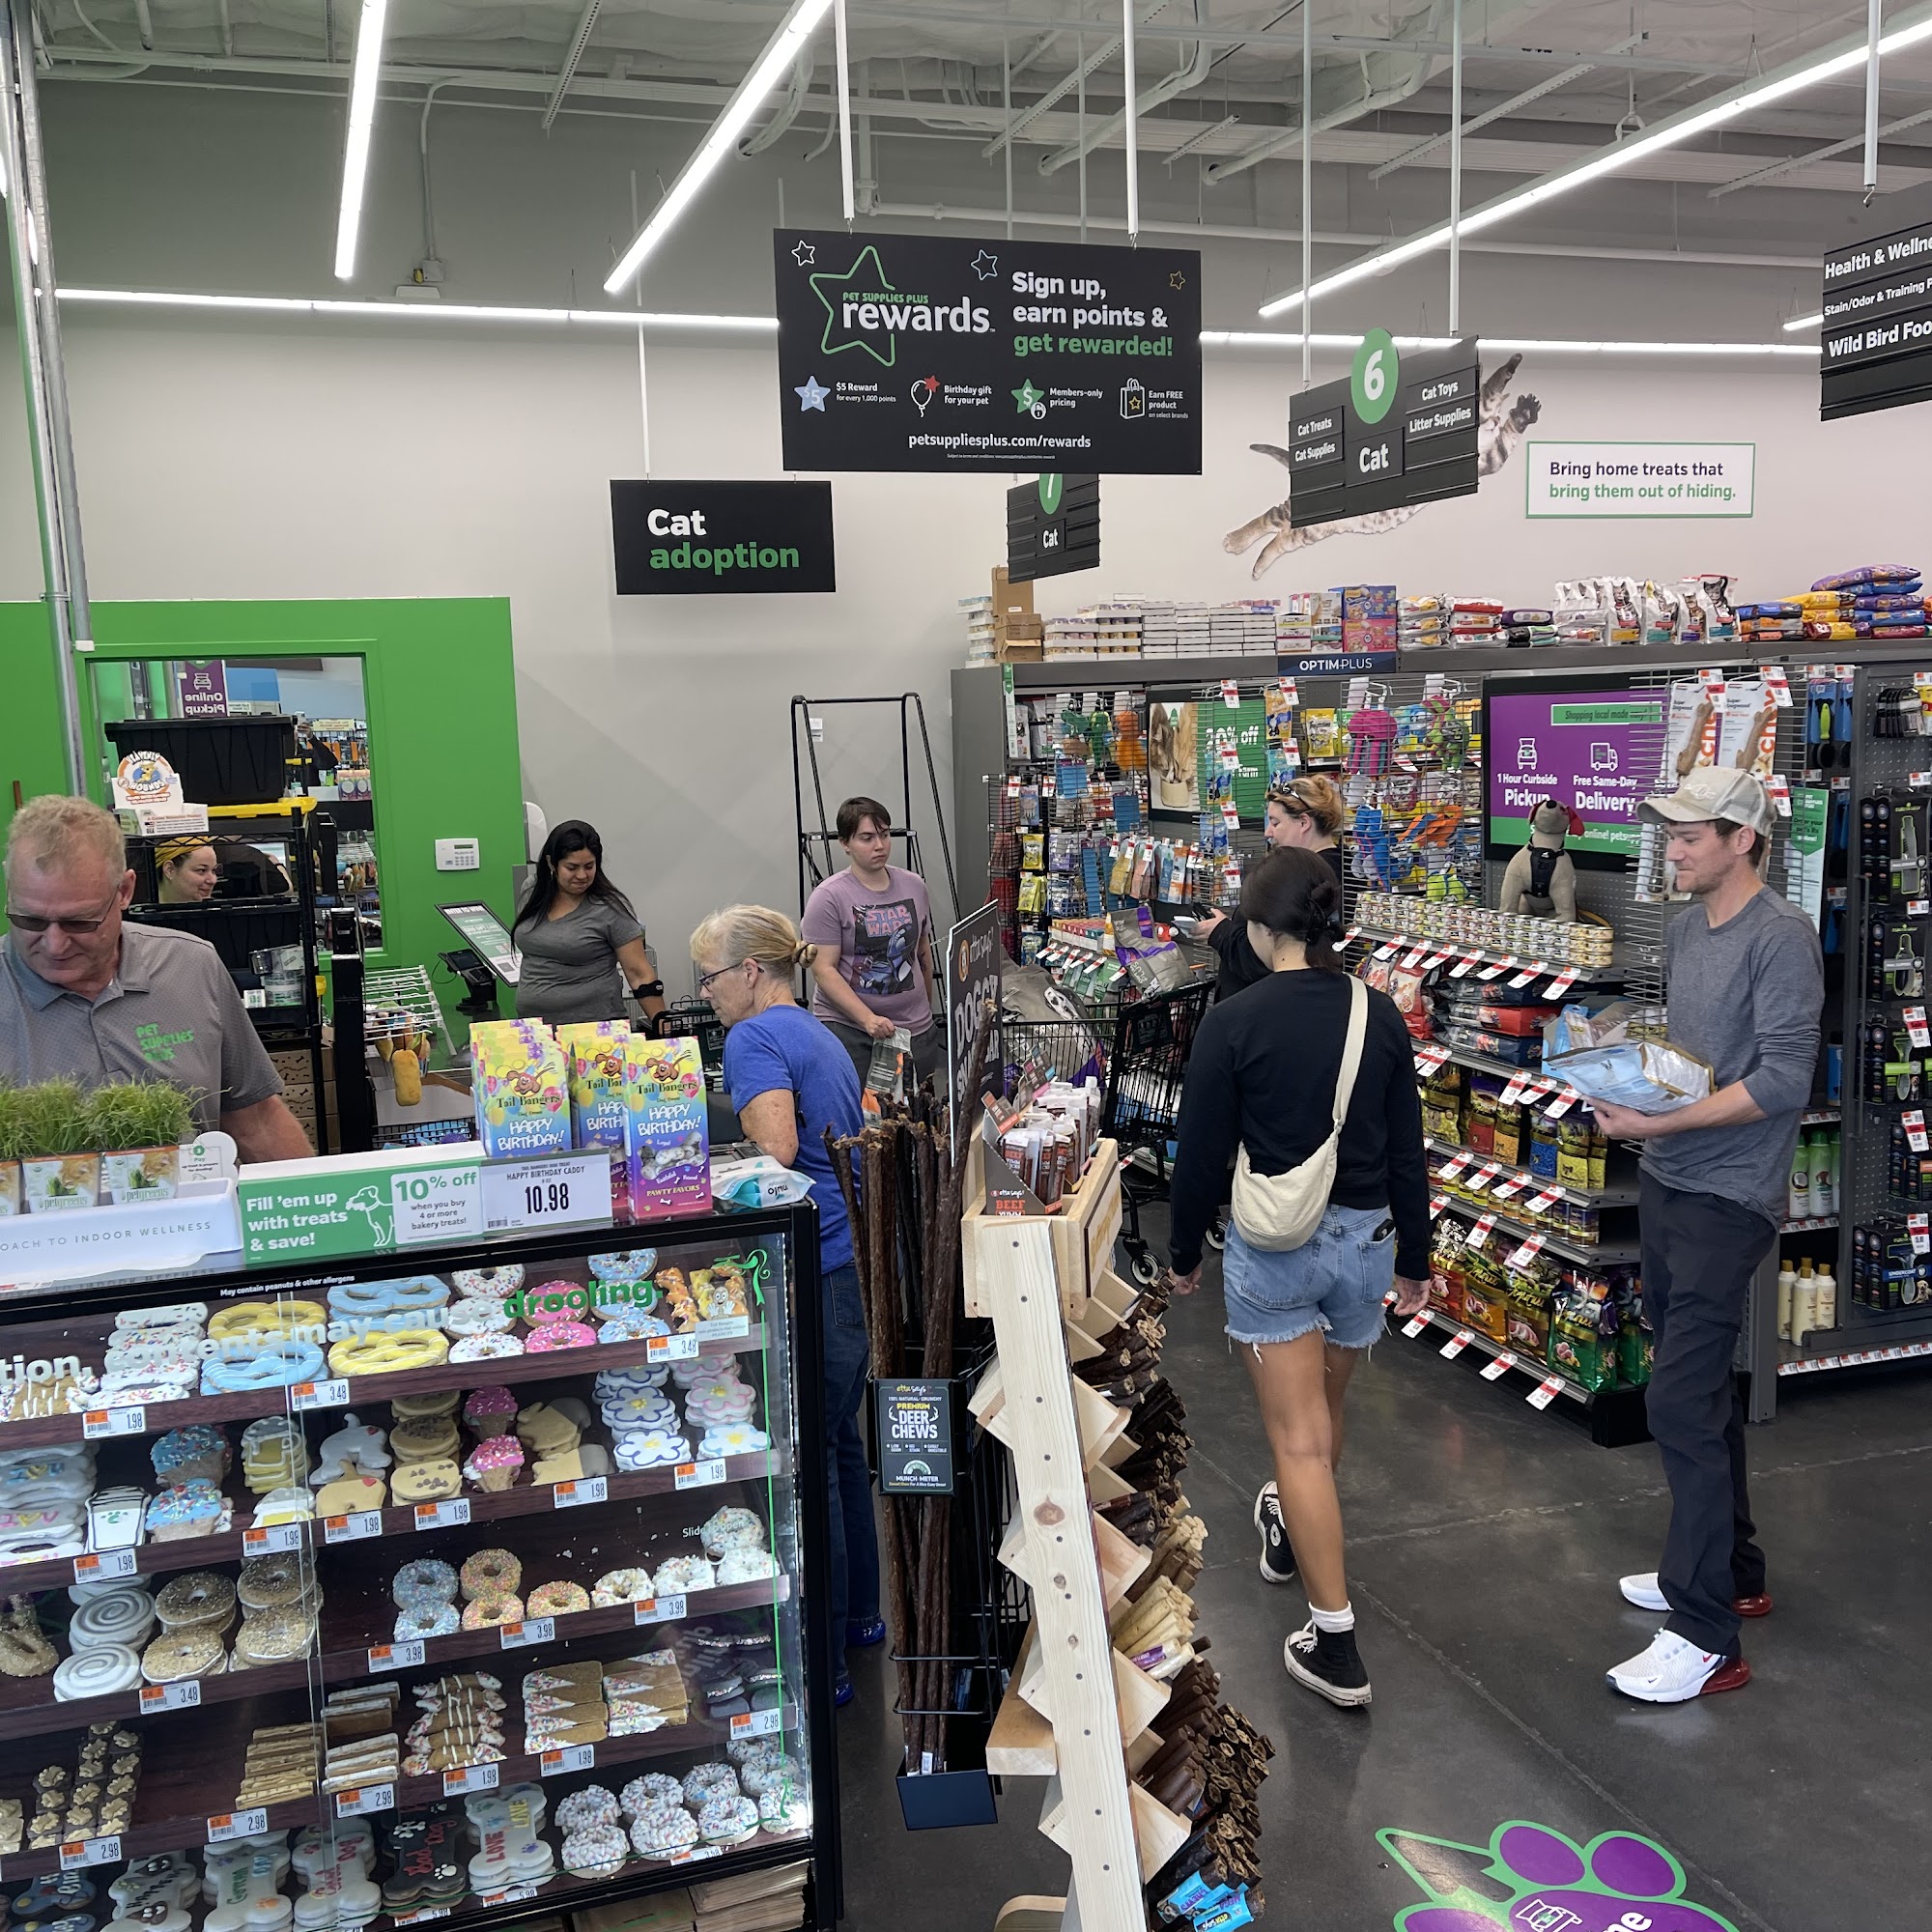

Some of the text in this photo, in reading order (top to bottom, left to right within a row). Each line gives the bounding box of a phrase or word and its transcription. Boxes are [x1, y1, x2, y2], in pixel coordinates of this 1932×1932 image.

[1825, 252, 1871, 279] Health
[1874, 248, 1886, 265] &
[1012, 271, 1107, 300] Sign up,
[842, 291, 929, 304] PET SUPPLIES PLUS
[1824, 295, 1875, 316] Stain/Odor
[1877, 291, 1885, 302] &
[1885, 281, 1925, 300] Training
[842, 297, 990, 333] rewards
[1012, 305, 1169, 329] earn points &
[1014, 334, 1174, 356] get rewarded!
[1828, 332, 1863, 357] Wild
[1866, 324, 1899, 349] Bird
[1364, 349, 1385, 401] 6
[836, 382, 878, 391] $5 Reward
[944, 385, 992, 396] Birthday gift
[1050, 387, 1103, 398] Members-only
[1149, 390, 1165, 399] Earn
[1421, 381, 1459, 401] Cat Toys
[944, 396, 989, 406] for your pet
[1050, 399, 1076, 409] pricing
[1149, 401, 1177, 410] product
[1297, 417, 1332, 437] Cat Treats
[1409, 407, 1471, 433] Litter Supplies
[908, 433, 1092, 450] petsuppliesplus.com/rewards
[1294, 442, 1336, 462] Cat Supplies
[1359, 443, 1389, 473] Cat
[1549, 461, 1724, 479] Bring home treats that
[1549, 483, 1736, 501] bring them out of hiding.
[647, 508, 707, 537] Cat
[1042, 527, 1059, 549] Cat
[649, 541, 800, 576] adoption
[1564, 710, 1593, 722] Shopping
[1594, 709, 1609, 719] local
[1610, 710, 1629, 719] made
[1240, 724, 1260, 745] off
[1497, 774, 1558, 785] 1 Hour Curbside
[1573, 775, 1637, 790] Free Same-Day
[1575, 791, 1636, 816] Delivery
[866, 904, 910, 922] STAR
[867, 918, 911, 936] WAR
[136, 1023, 158, 1038] PET
[140, 1030, 194, 1051] SUPPLIES
[636, 1083, 655, 1094] Tail
[659, 1081, 698, 1094] Bangers
[496, 1094, 560, 1108] Tail Bangers
[648, 1103, 692, 1122] HAPPY
[509, 1117, 554, 1135] HAPPY
[637, 1115, 702, 1137] BIRTHDAY!
[497, 1129, 566, 1151] BIRTHDAY!
[506, 1166, 585, 1180] HAPPY BIRTHDAY CADDY
[126, 1187, 170, 1203] petgreens
[394, 1172, 477, 1202] 10% off
[646, 1184, 700, 1197] PAWTY FAVORS
[246, 1192, 338, 1212] Fill 'em up
[434, 1201, 449, 1209] you
[525, 1182, 570, 1214] 10.98
[996, 1200, 1026, 1209] BEEF
[247, 1210, 348, 1232] with treats
[412, 1217, 468, 1230] bakery treats!
[48, 1236, 68, 1246] TO
[74, 1230, 132, 1244] INDOOR
[139, 1221, 212, 1236] WELLNESS
[249, 1232, 316, 1252] & save!
[237, 1284, 265, 1294] contain
[265, 1281, 294, 1292] peanuts
[302, 1278, 323, 1287] other
[323, 1275, 355, 1286] allergens
[289, 1315, 373, 1346] may
[384, 1300, 495, 1334] cause
[503, 1280, 663, 1319] drooling.
[681, 1339, 696, 1354] 3.48
[126, 1413, 143, 1430] 1.98
[898, 1410, 929, 1425] DEER
[892, 1424, 939, 1439] CHEWS
[590, 1483, 606, 1498] 1.98
[364, 1516, 380, 1533] 1.98
[682, 1525, 706, 1538] Slide
[284, 1529, 299, 1546] 1.98
[405, 1645, 423, 1662] 3.98
[180, 1686, 198, 1703] 3.48
[763, 1713, 780, 1729] 2.98
[100, 1842, 120, 1860] 2.98
